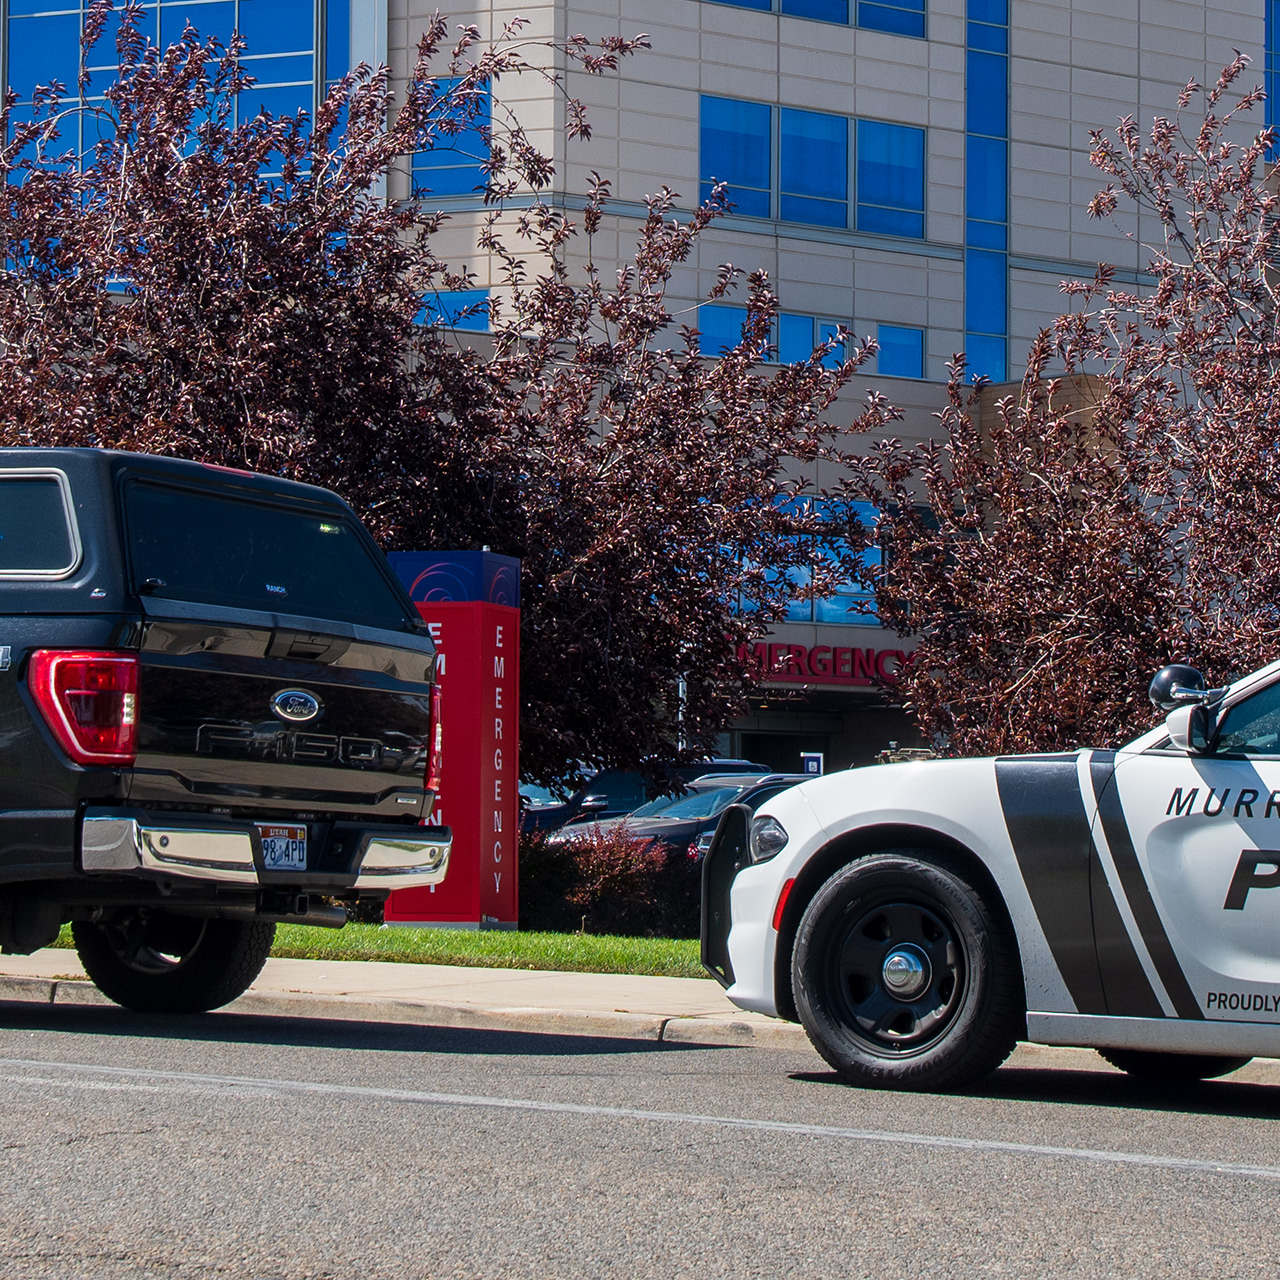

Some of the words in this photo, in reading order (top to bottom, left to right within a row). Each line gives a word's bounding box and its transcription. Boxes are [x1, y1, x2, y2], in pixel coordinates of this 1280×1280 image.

[733, 641, 917, 680] MERGENCY
[286, 696, 313, 714] Ford
[492, 625, 505, 894] EMERGENCY
[270, 829, 289, 837] UTAH
[262, 839, 277, 861] 98
